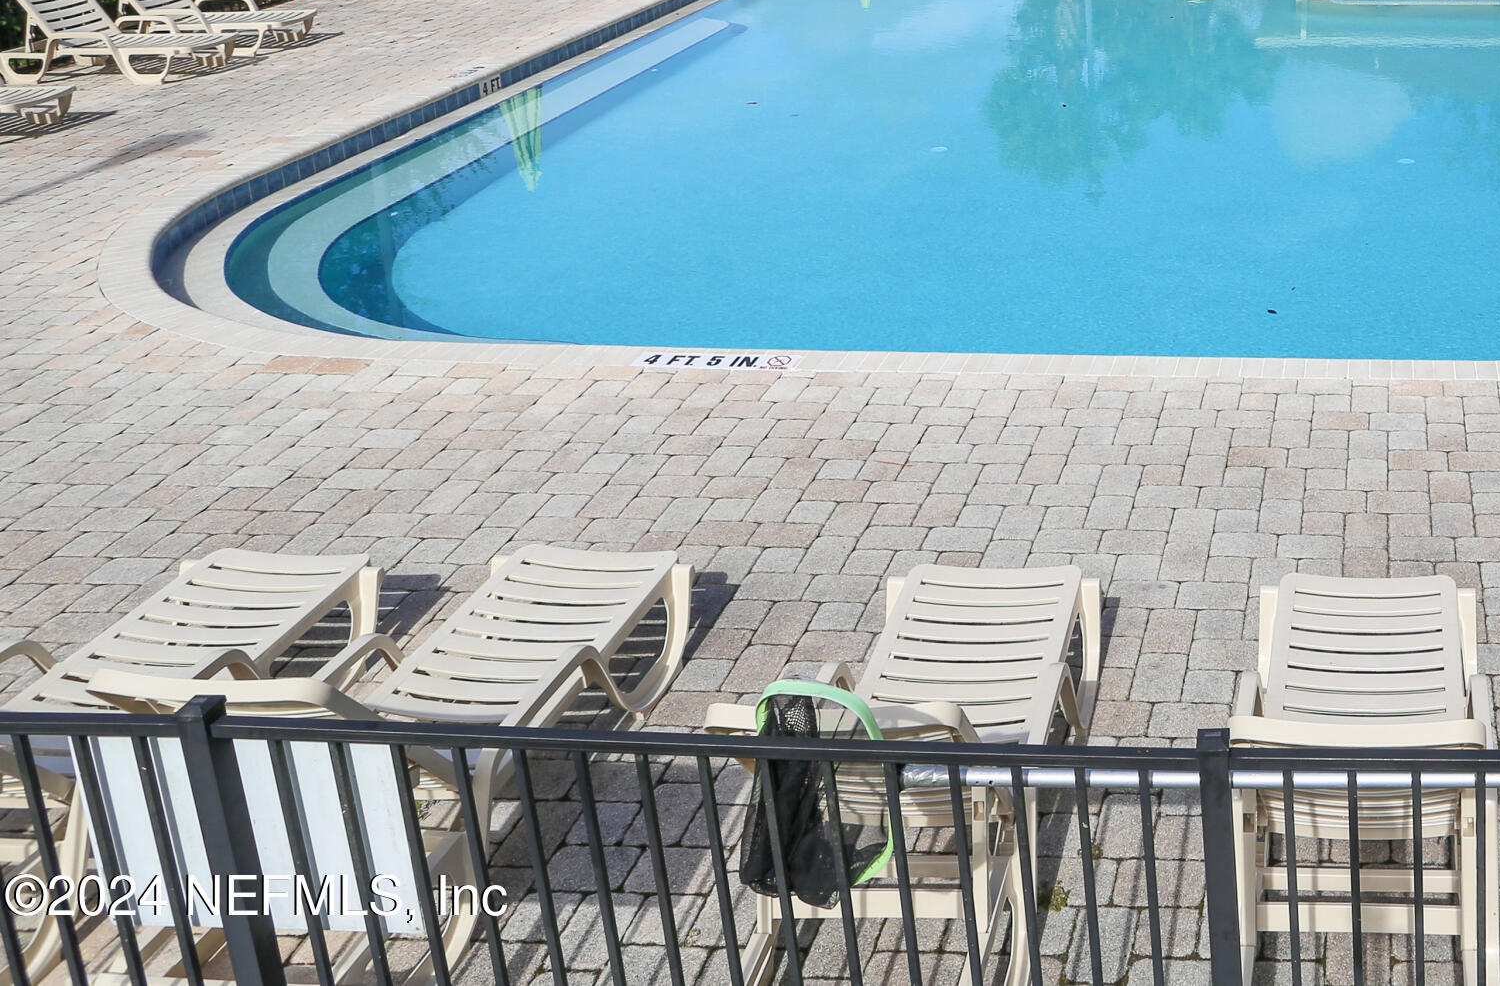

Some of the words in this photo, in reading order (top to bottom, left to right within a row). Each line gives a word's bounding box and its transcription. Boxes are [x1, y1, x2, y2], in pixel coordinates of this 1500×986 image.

[483, 82, 488, 95] 4
[644, 354, 662, 365] 4
[666, 355, 701, 366] FT.
[706, 355, 726, 367] 5
[729, 356, 760, 368] IN.
